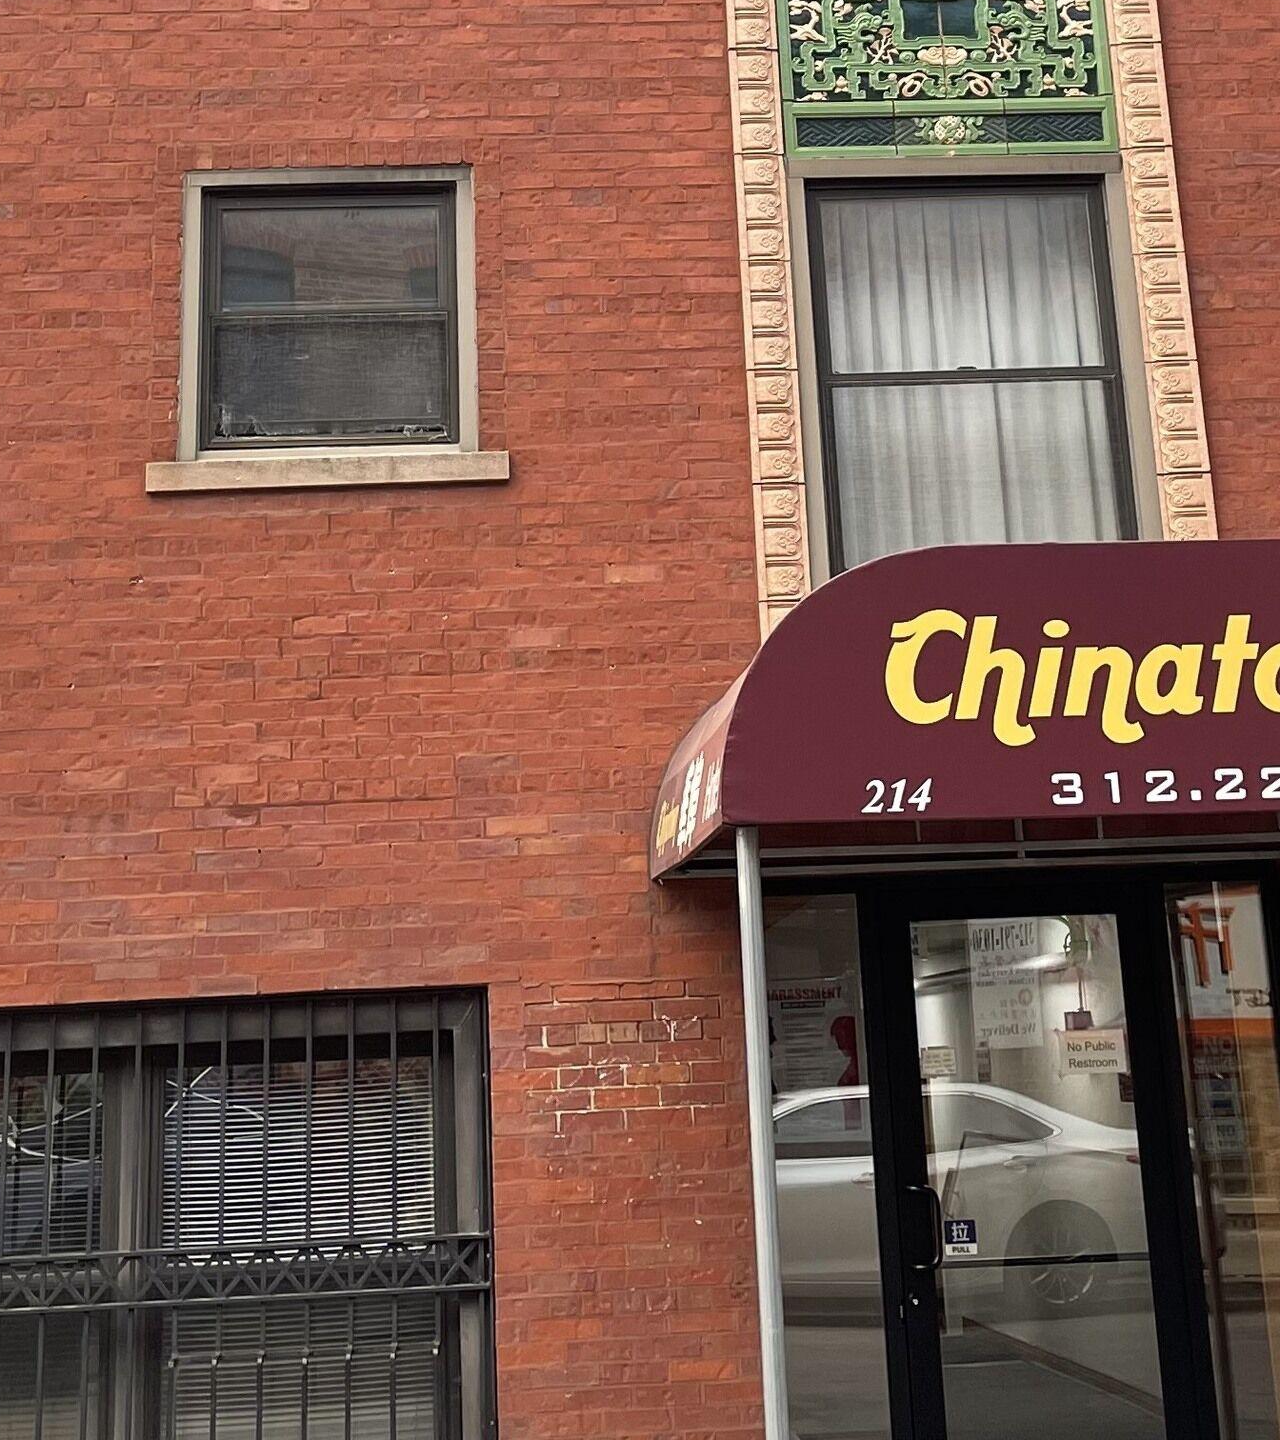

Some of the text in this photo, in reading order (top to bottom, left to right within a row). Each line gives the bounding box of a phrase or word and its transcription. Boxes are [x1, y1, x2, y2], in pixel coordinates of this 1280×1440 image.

[861, 777, 933, 814] 214
[1067, 1040, 1116, 1052] No Public
[1068, 1058, 1118, 1068] Restroom
[951, 1222, 970, 1242] 拉
[952, 1246, 971, 1254] PULL
